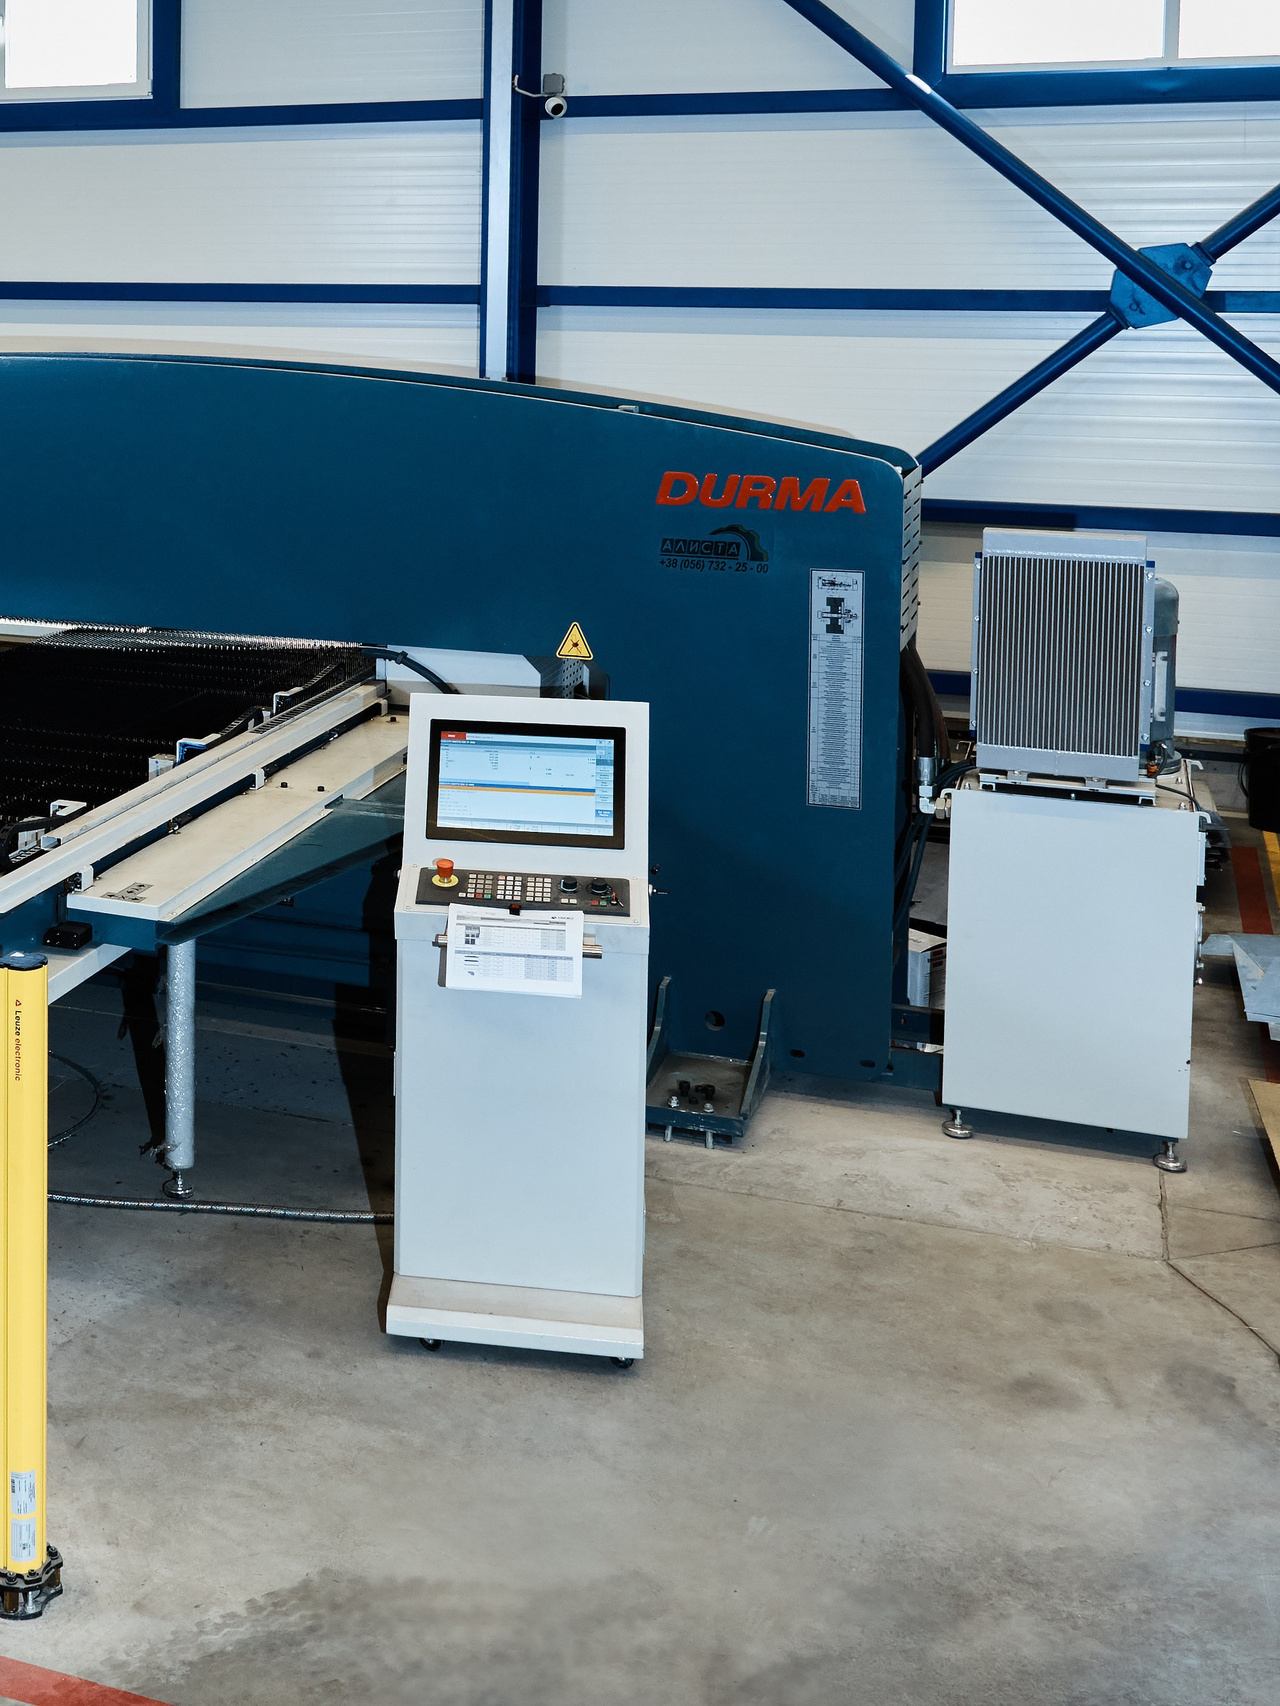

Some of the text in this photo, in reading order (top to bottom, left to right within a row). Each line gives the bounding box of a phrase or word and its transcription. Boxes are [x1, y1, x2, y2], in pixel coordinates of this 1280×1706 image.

[655, 471, 866, 514] DURMA
[661, 539, 740, 556] АЛИСТА
[660, 558, 677, 568] +38
[680, 559, 705, 572] (056)
[708, 560, 726, 571] 732
[735, 562, 747, 572] 25
[756, 563, 769, 573] 00
[14, 1010, 22, 1082] Leuze electronic
